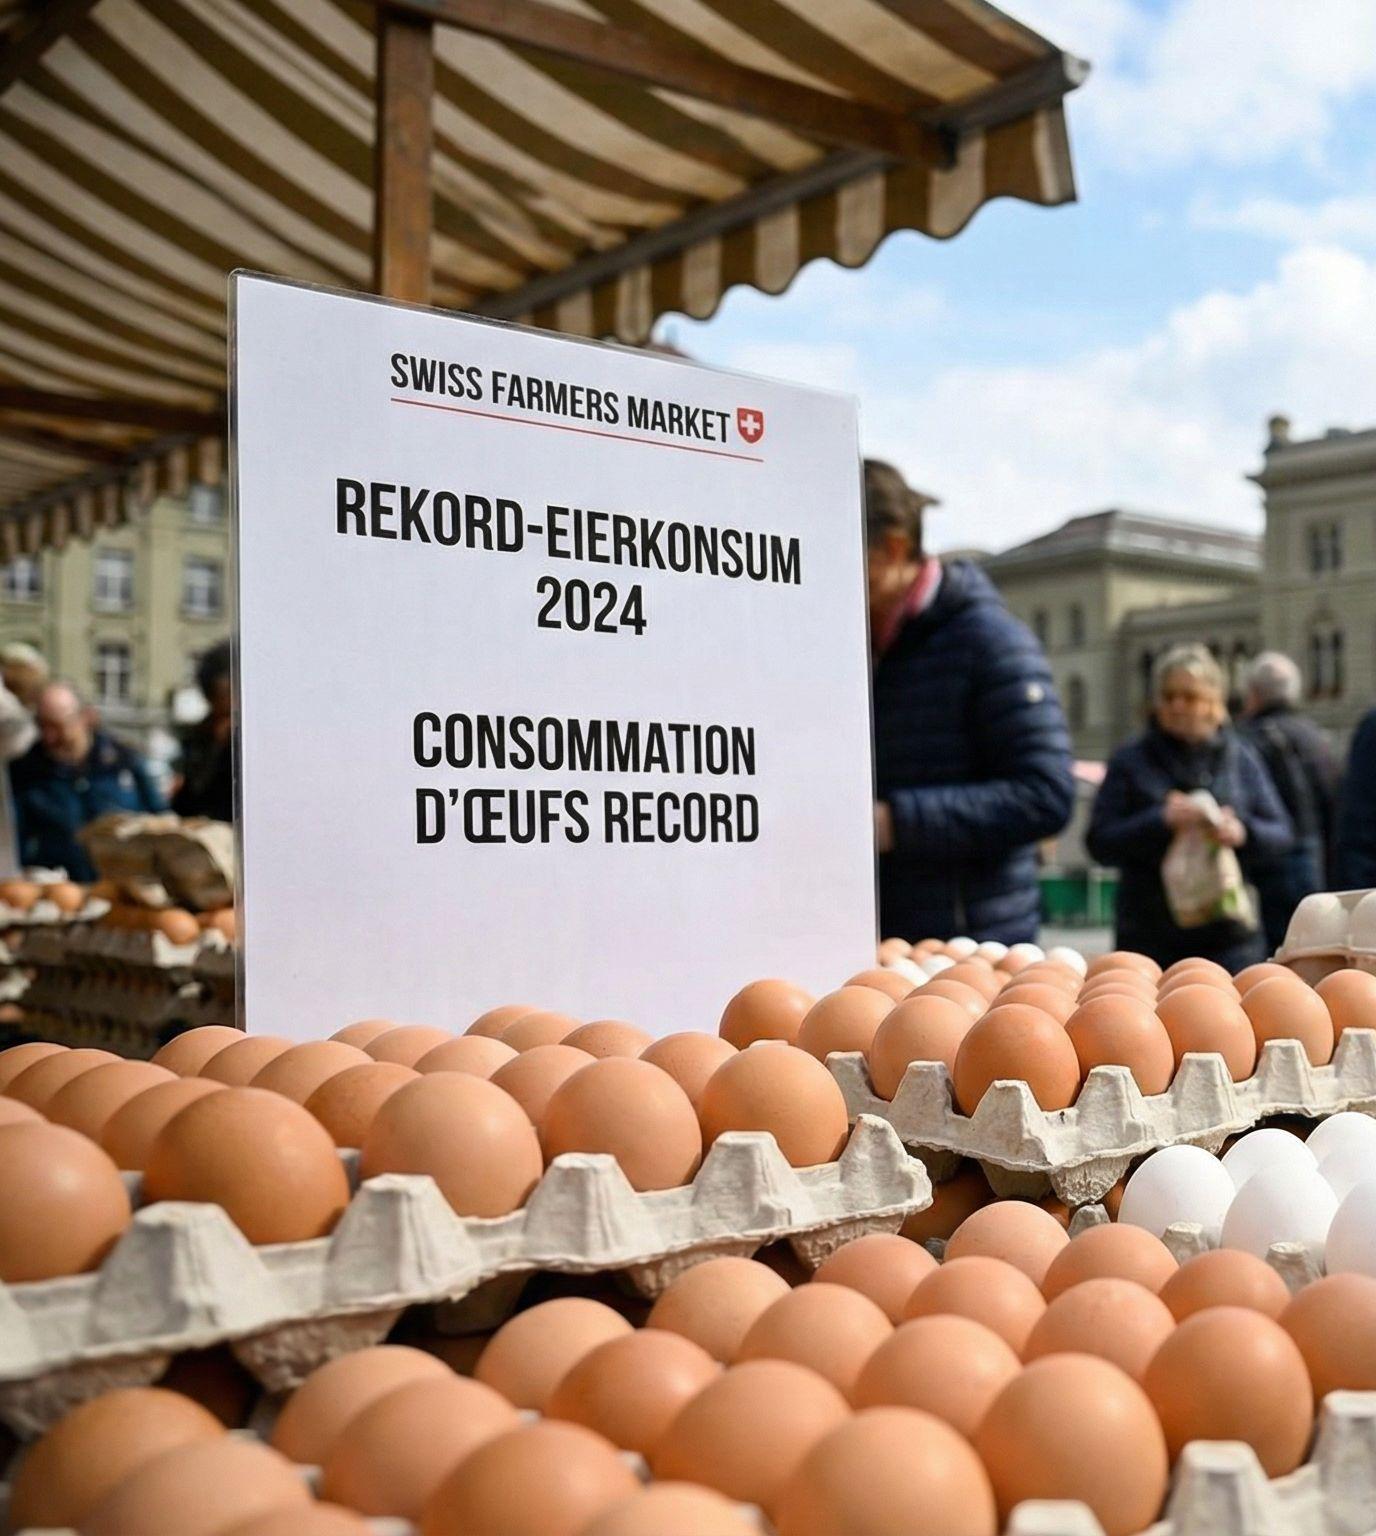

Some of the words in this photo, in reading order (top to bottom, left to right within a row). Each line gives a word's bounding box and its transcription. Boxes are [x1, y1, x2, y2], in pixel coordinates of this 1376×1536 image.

[390, 353, 483, 401] SWISS
[491, 370, 620, 425] FARMERS
[627, 395, 731, 443] MARKET
[336, 477, 801, 585] REKORD-EIERKONSUM
[536, 575, 647, 636] 2024
[413, 711, 756, 776] CONSOMMATION
[415, 788, 590, 844] D’ŒUFS
[603, 790, 759, 844] RECORD
